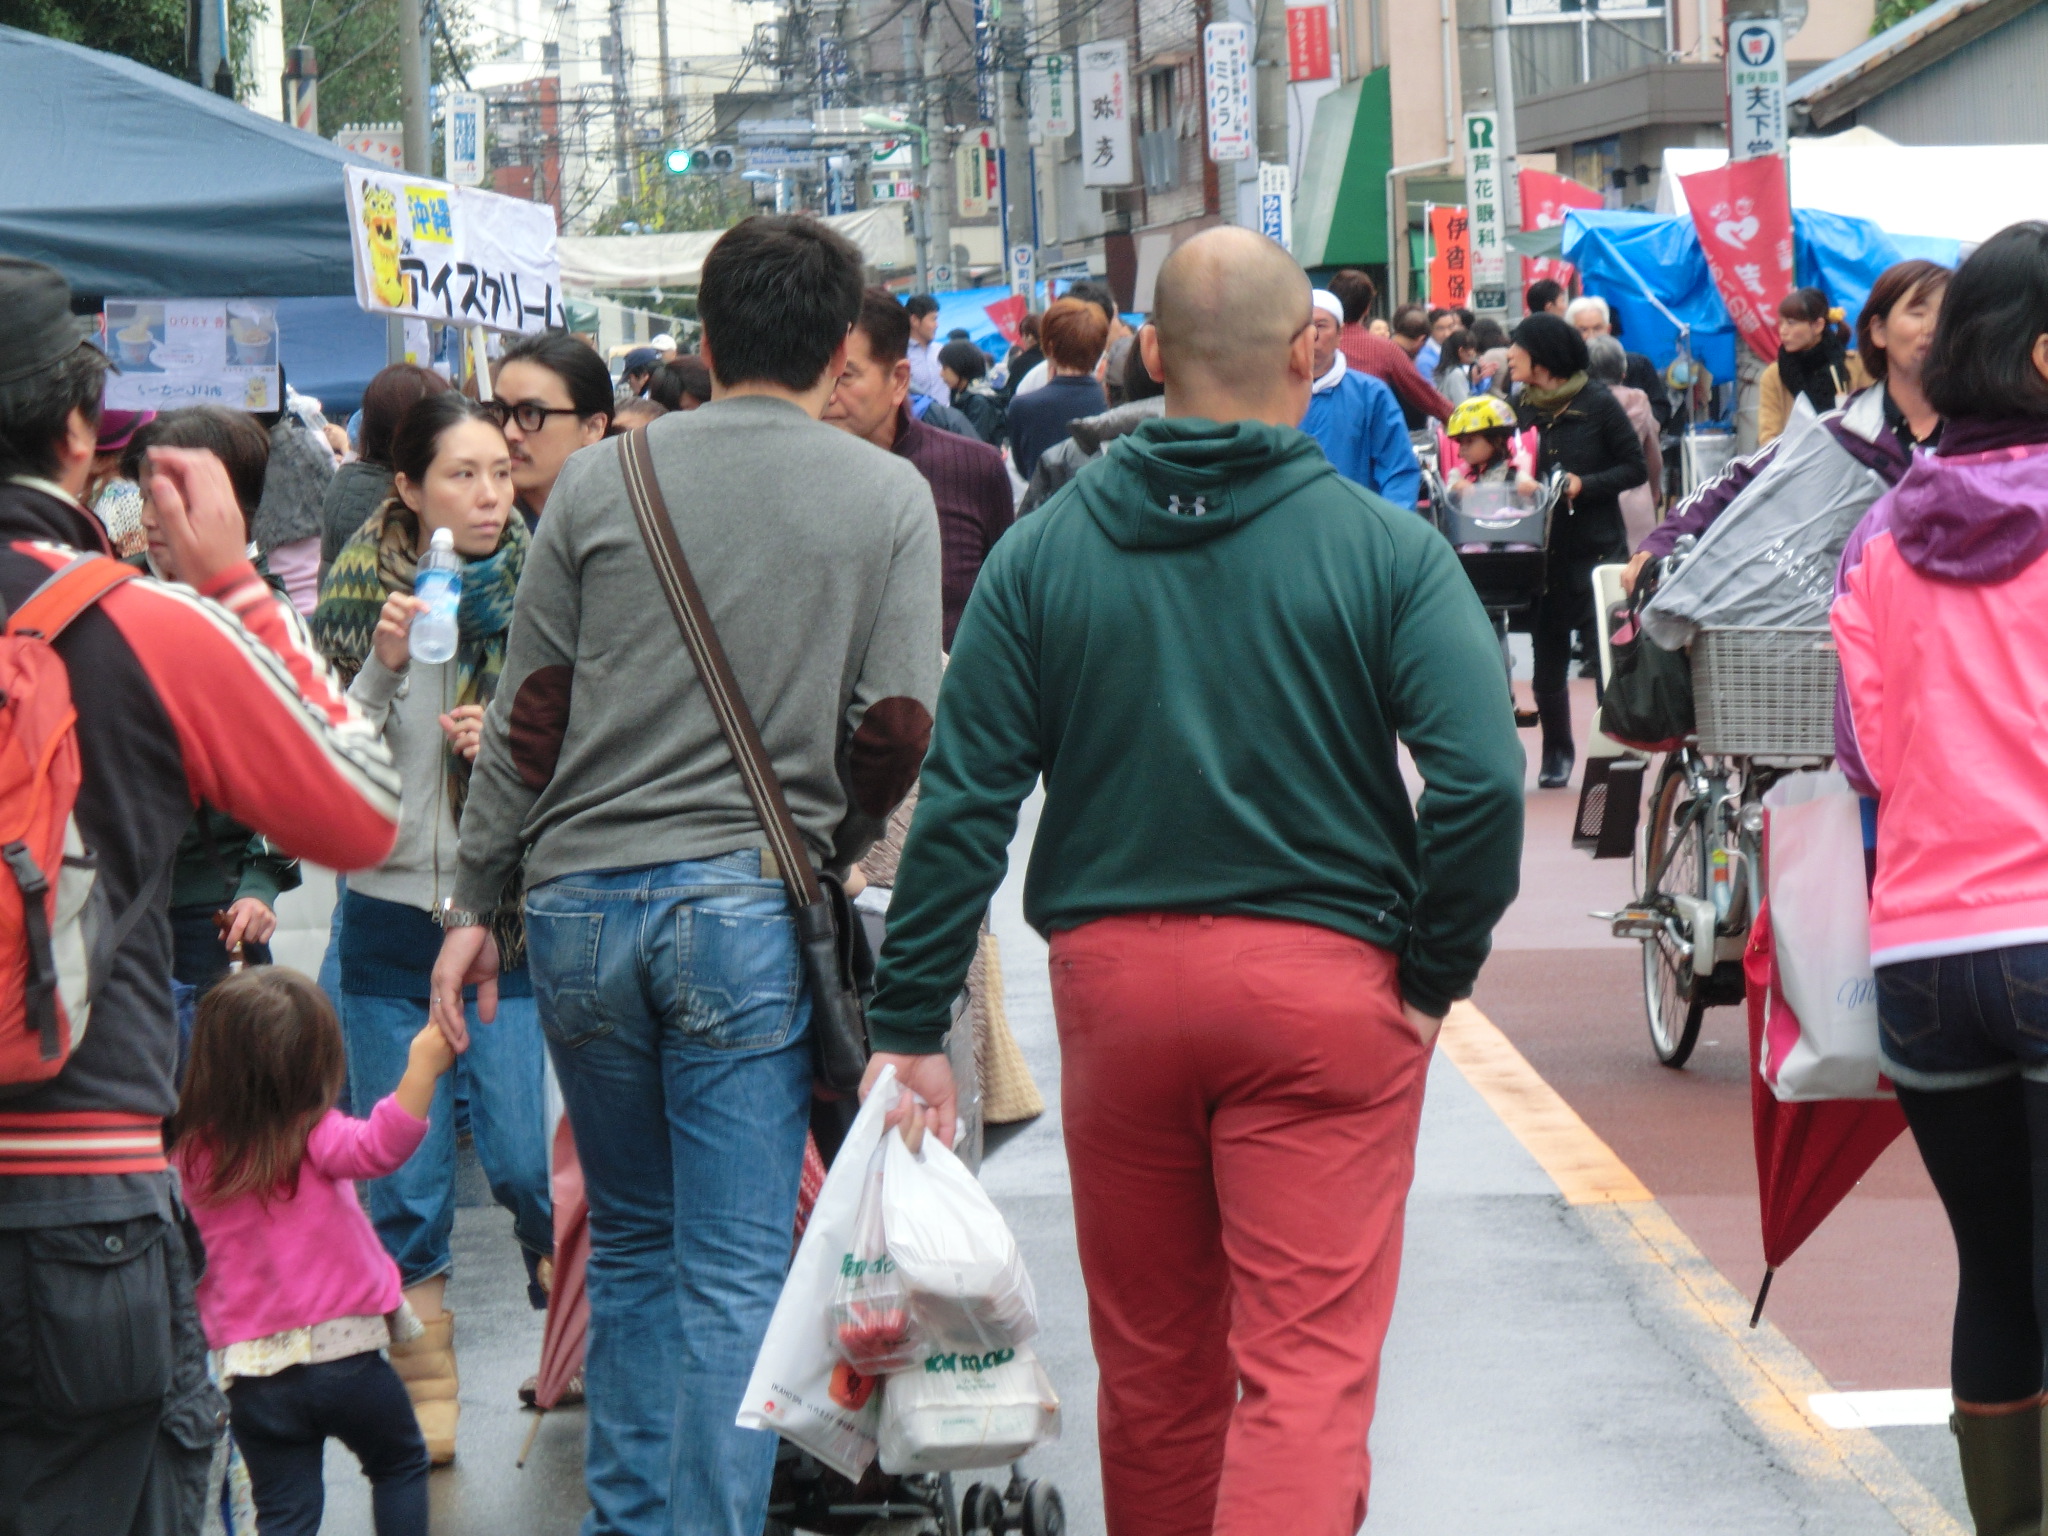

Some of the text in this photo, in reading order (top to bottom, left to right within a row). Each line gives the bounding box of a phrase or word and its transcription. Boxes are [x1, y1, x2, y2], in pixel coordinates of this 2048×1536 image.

[1216, 60, 1231, 127] ミウラ
[407, 194, 453, 238] 沖縄
[1473, 153, 1497, 249] 芦花眼科
[400, 257, 570, 334] アイスクリーム
[1765, 549, 1799, 579] NEW
